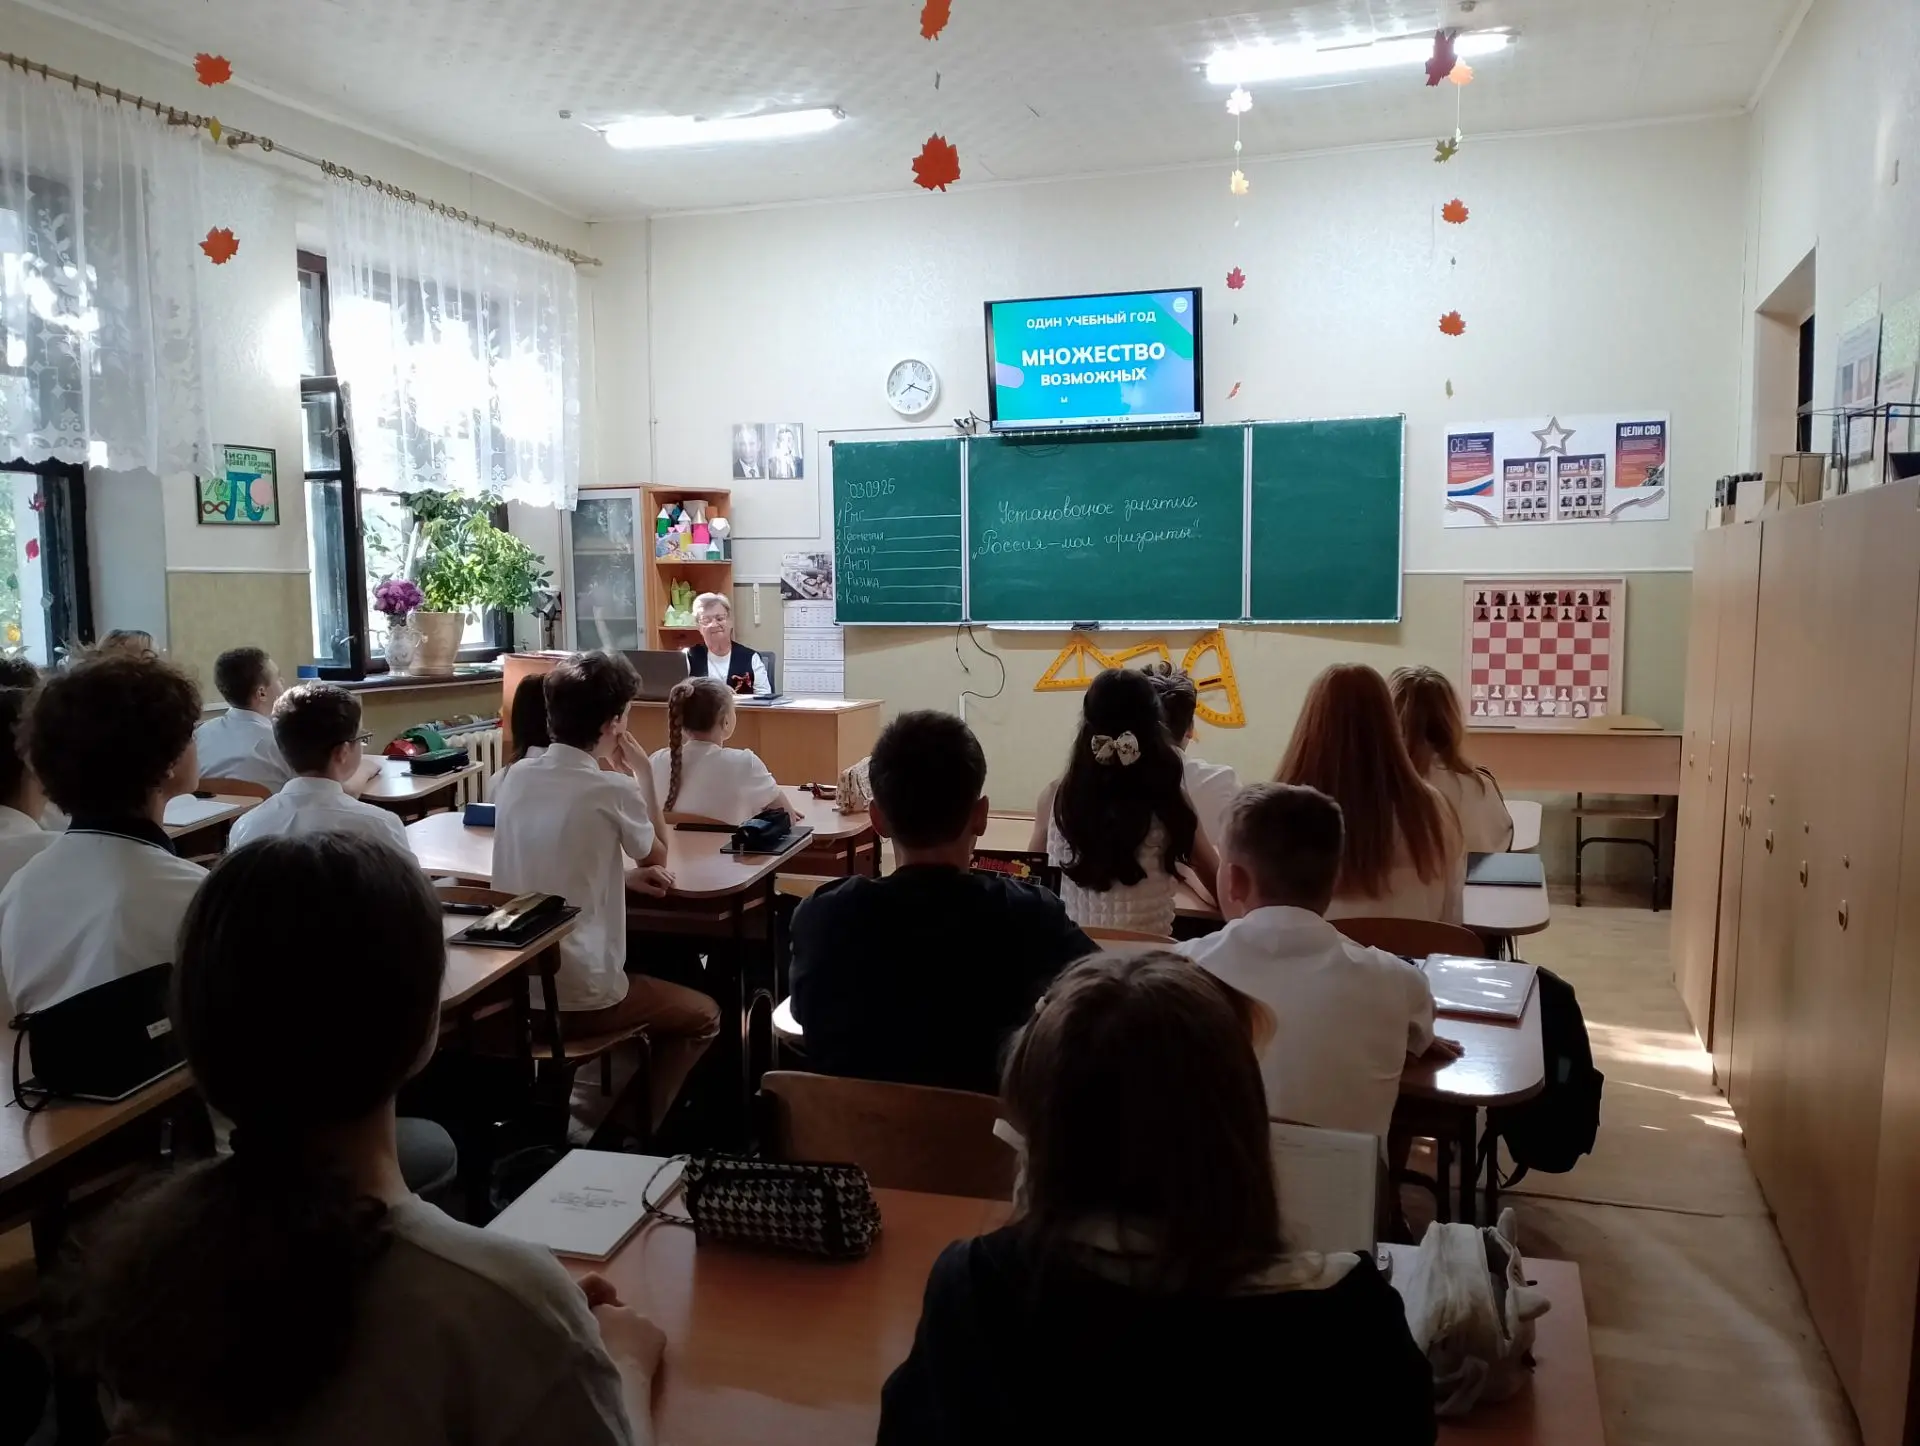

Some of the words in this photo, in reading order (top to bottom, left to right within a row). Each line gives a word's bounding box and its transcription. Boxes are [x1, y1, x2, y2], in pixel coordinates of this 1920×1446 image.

[1026, 317, 1062, 329] ОДИН
[1067, 311, 1127, 327] УЧЕБНЫЙ
[1129, 311, 1157, 323] ГОД
[1021, 342, 1166, 366] МНОЖЕСТВО
[1040, 367, 1147, 386] ВОЗМОЖНЫХ
[1620, 426, 1644, 437] ЦЕЛИ
[1644, 425, 1661, 435] СВО
[1124, 494, 1198, 521] занятие
